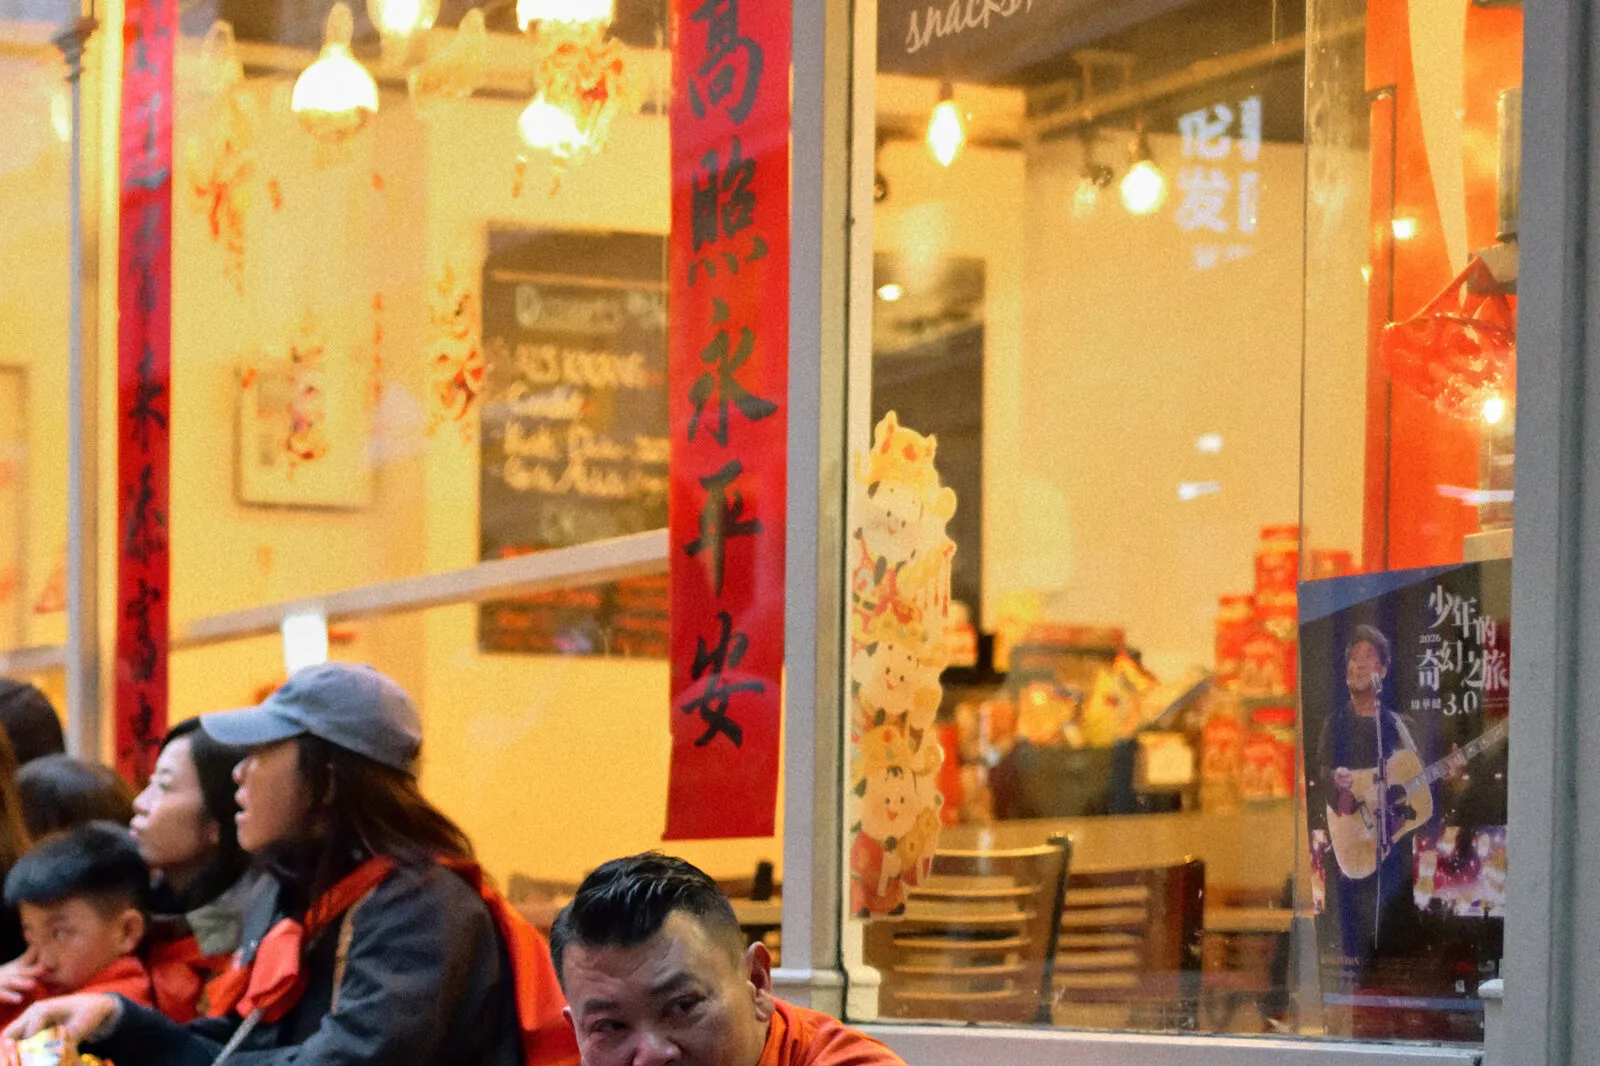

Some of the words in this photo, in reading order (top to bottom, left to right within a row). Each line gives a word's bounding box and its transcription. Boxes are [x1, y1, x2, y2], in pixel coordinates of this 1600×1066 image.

[1427, 584, 1496, 647] 少年的
[1415, 639, 1509, 692] 奇幻之旅
[1443, 690, 1477, 716] 3.0
